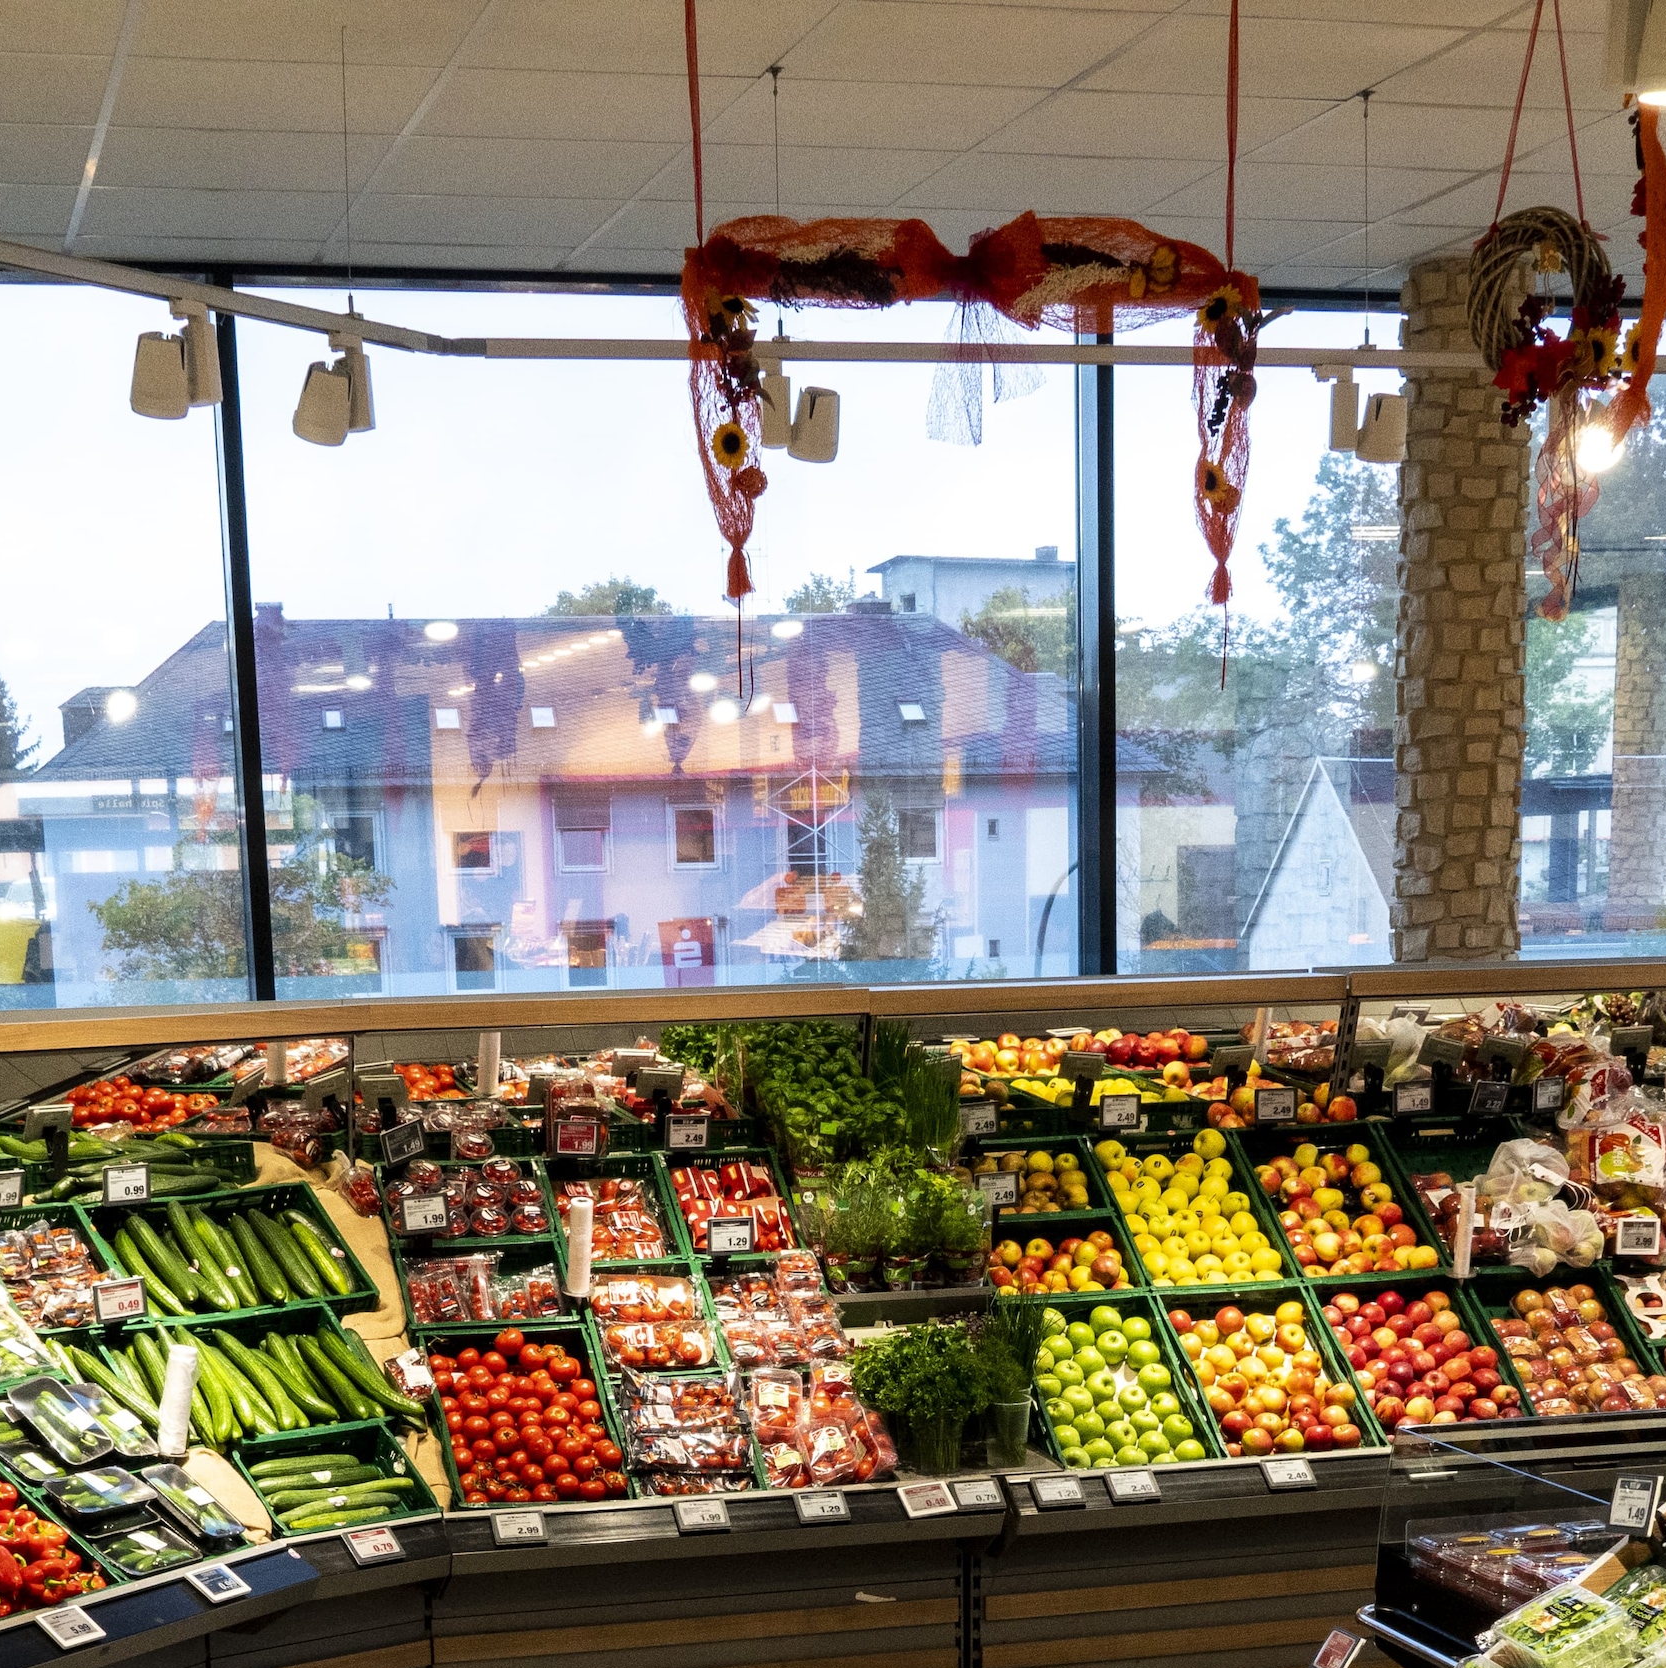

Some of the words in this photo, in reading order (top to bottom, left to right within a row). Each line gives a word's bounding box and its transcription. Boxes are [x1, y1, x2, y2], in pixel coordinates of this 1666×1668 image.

[1411, 1098, 1428, 1107] 1.49
[1273, 1106, 1291, 1115] 2.49
[1117, 1113, 1135, 1122] 2.49
[975, 1121, 995, 1130] 2.49
[685, 1134, 704, 1143] 2.49
[573, 1140, 592, 1150] 1.99
[125, 1186, 144, 1195] 0.99
[995, 1190, 1014, 1200] 2.49
[423, 1213, 444, 1223] 1.99
[728, 1237, 747, 1246] 1.29
[118, 1300, 139, 1310] 0.49
[1286, 1472, 1308, 1480] 2.49
[976, 1494, 997, 1502] 0.79
[820, 1505, 840, 1514] 1.29
[1628, 1507, 1645, 1520] 1.49
[700, 1513, 721, 1522] 1.99
[517, 1526, 539, 1534] 2.99
[373, 1542, 394, 1553] 0.79
[70, 1623, 92, 1634] 5.99
